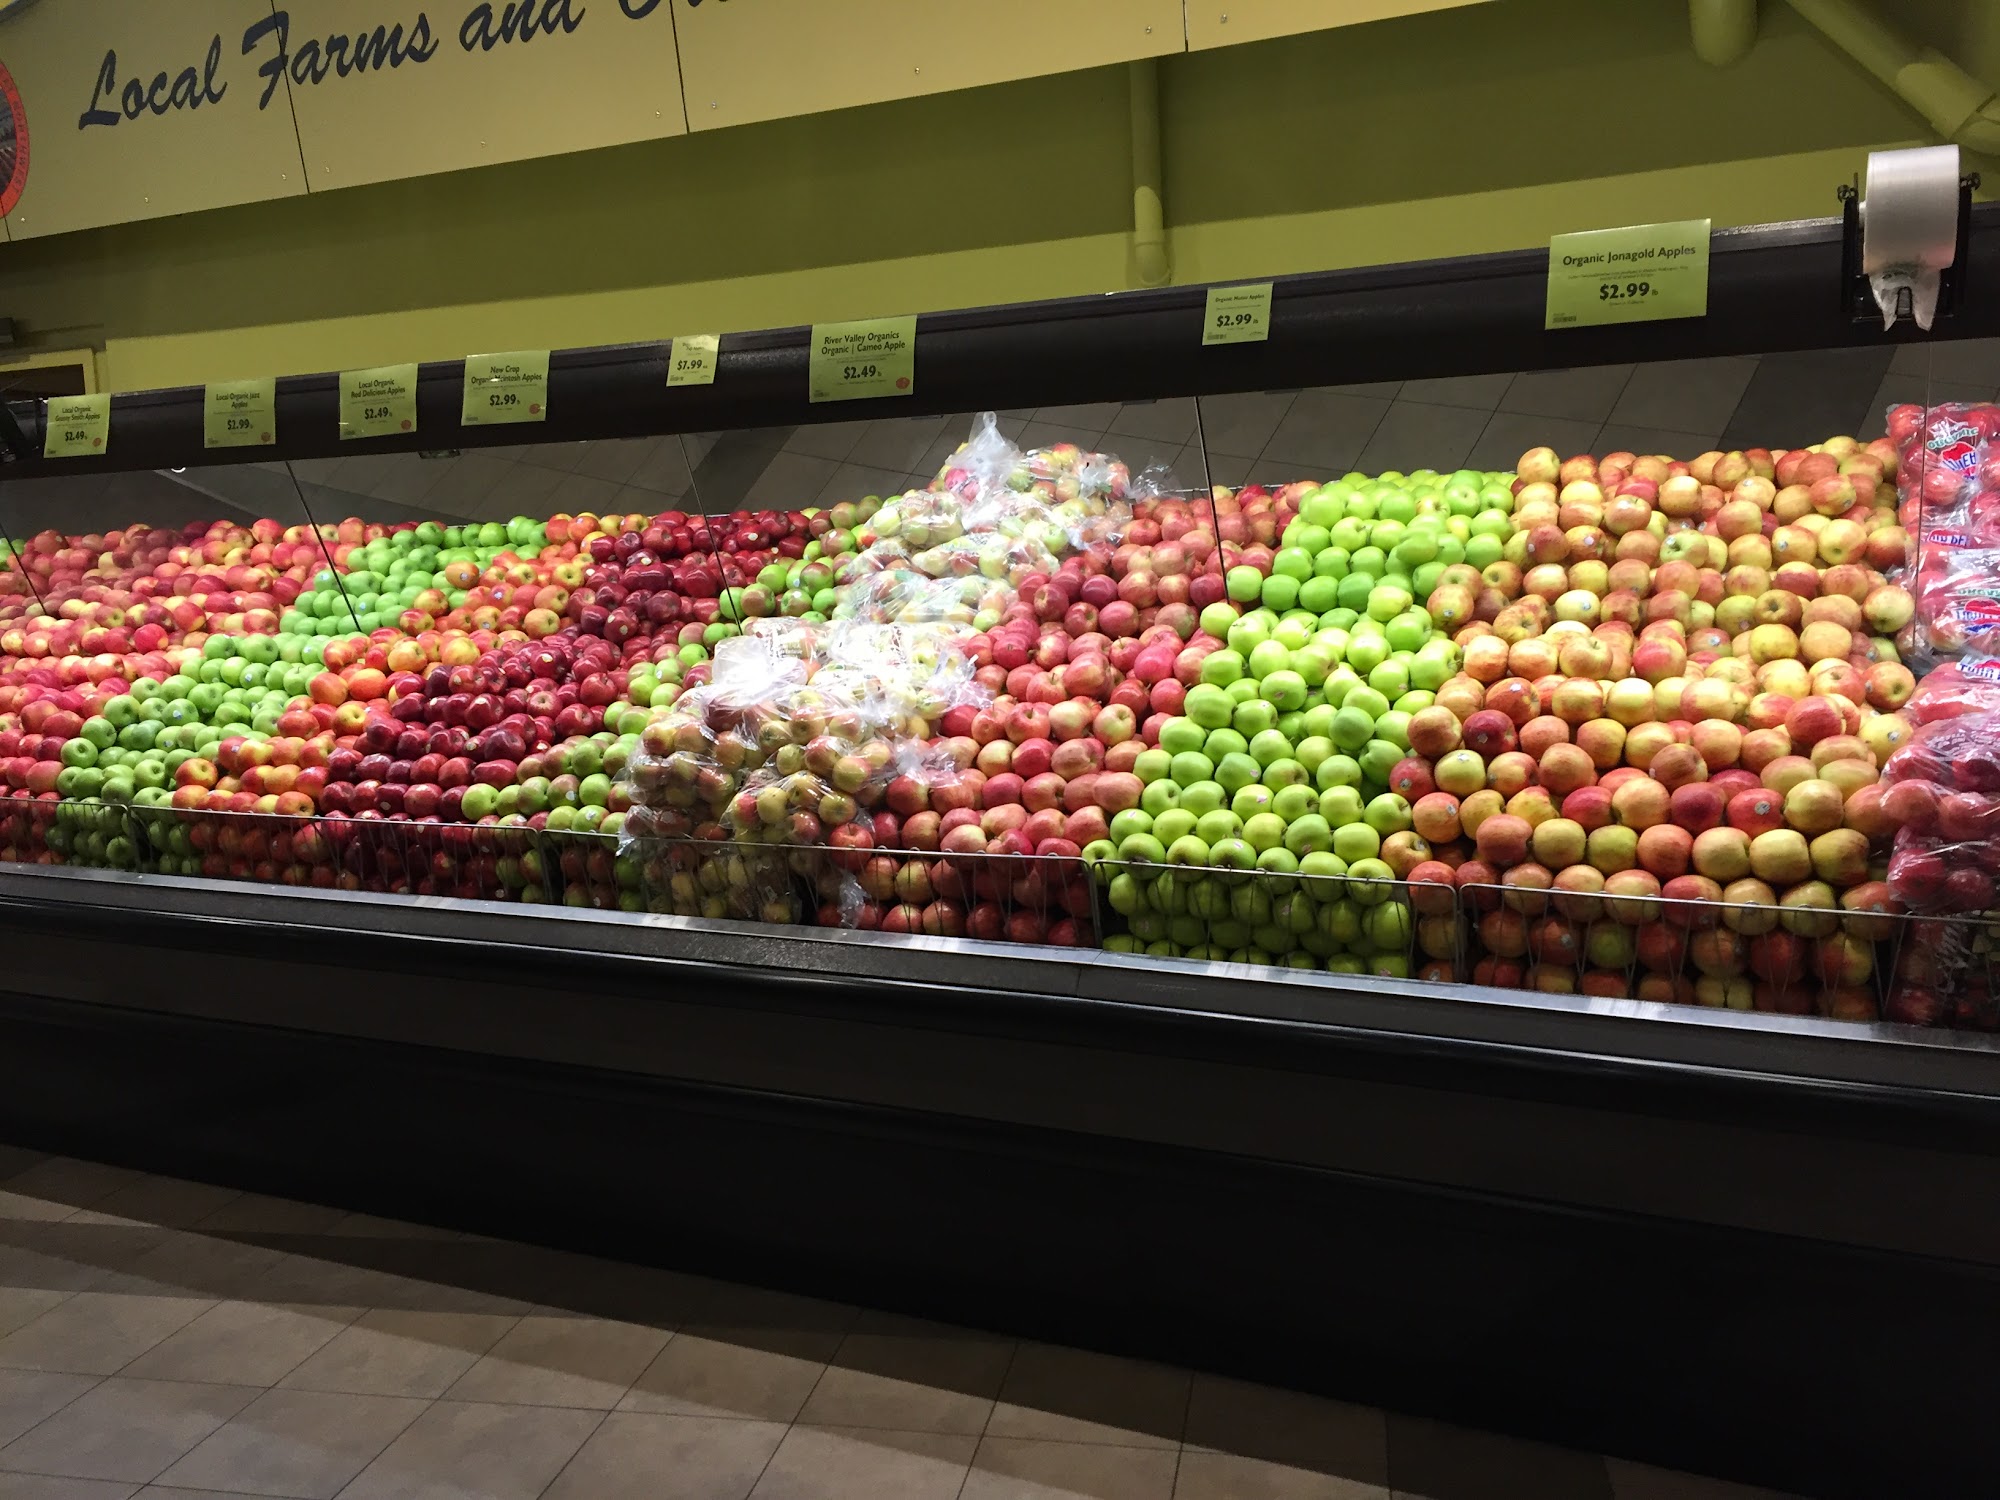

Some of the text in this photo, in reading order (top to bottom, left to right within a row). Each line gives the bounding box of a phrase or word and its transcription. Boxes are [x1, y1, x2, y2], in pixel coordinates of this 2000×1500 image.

[79, 0, 586, 130] Local Farms and
[1563, 246, 1696, 267] Organic Jonagold Apples
[1600, 282, 1650, 301] $2.99
[1217, 314, 1251, 328] $2.99
[824, 331, 899, 344] River Valley Organics
[821, 346, 849, 356] Organic
[857, 343, 882, 352] Cameo
[884, 341, 905, 351] Apple
[505, 365, 520, 373] Crop
[677, 360, 702, 370] $7.99
[844, 365, 876, 380] $2.49
[359, 379, 394, 388] Local Organic
[230, 392, 248, 401] Organic
[363, 389, 386, 397] Delicious
[387, 387, 405, 395] Apples
[490, 394, 516, 406] $2.99
[365, 407, 388, 419] $2.49
[228, 419, 249, 430] $2.99
[65, 431, 84, 441] $2.49
